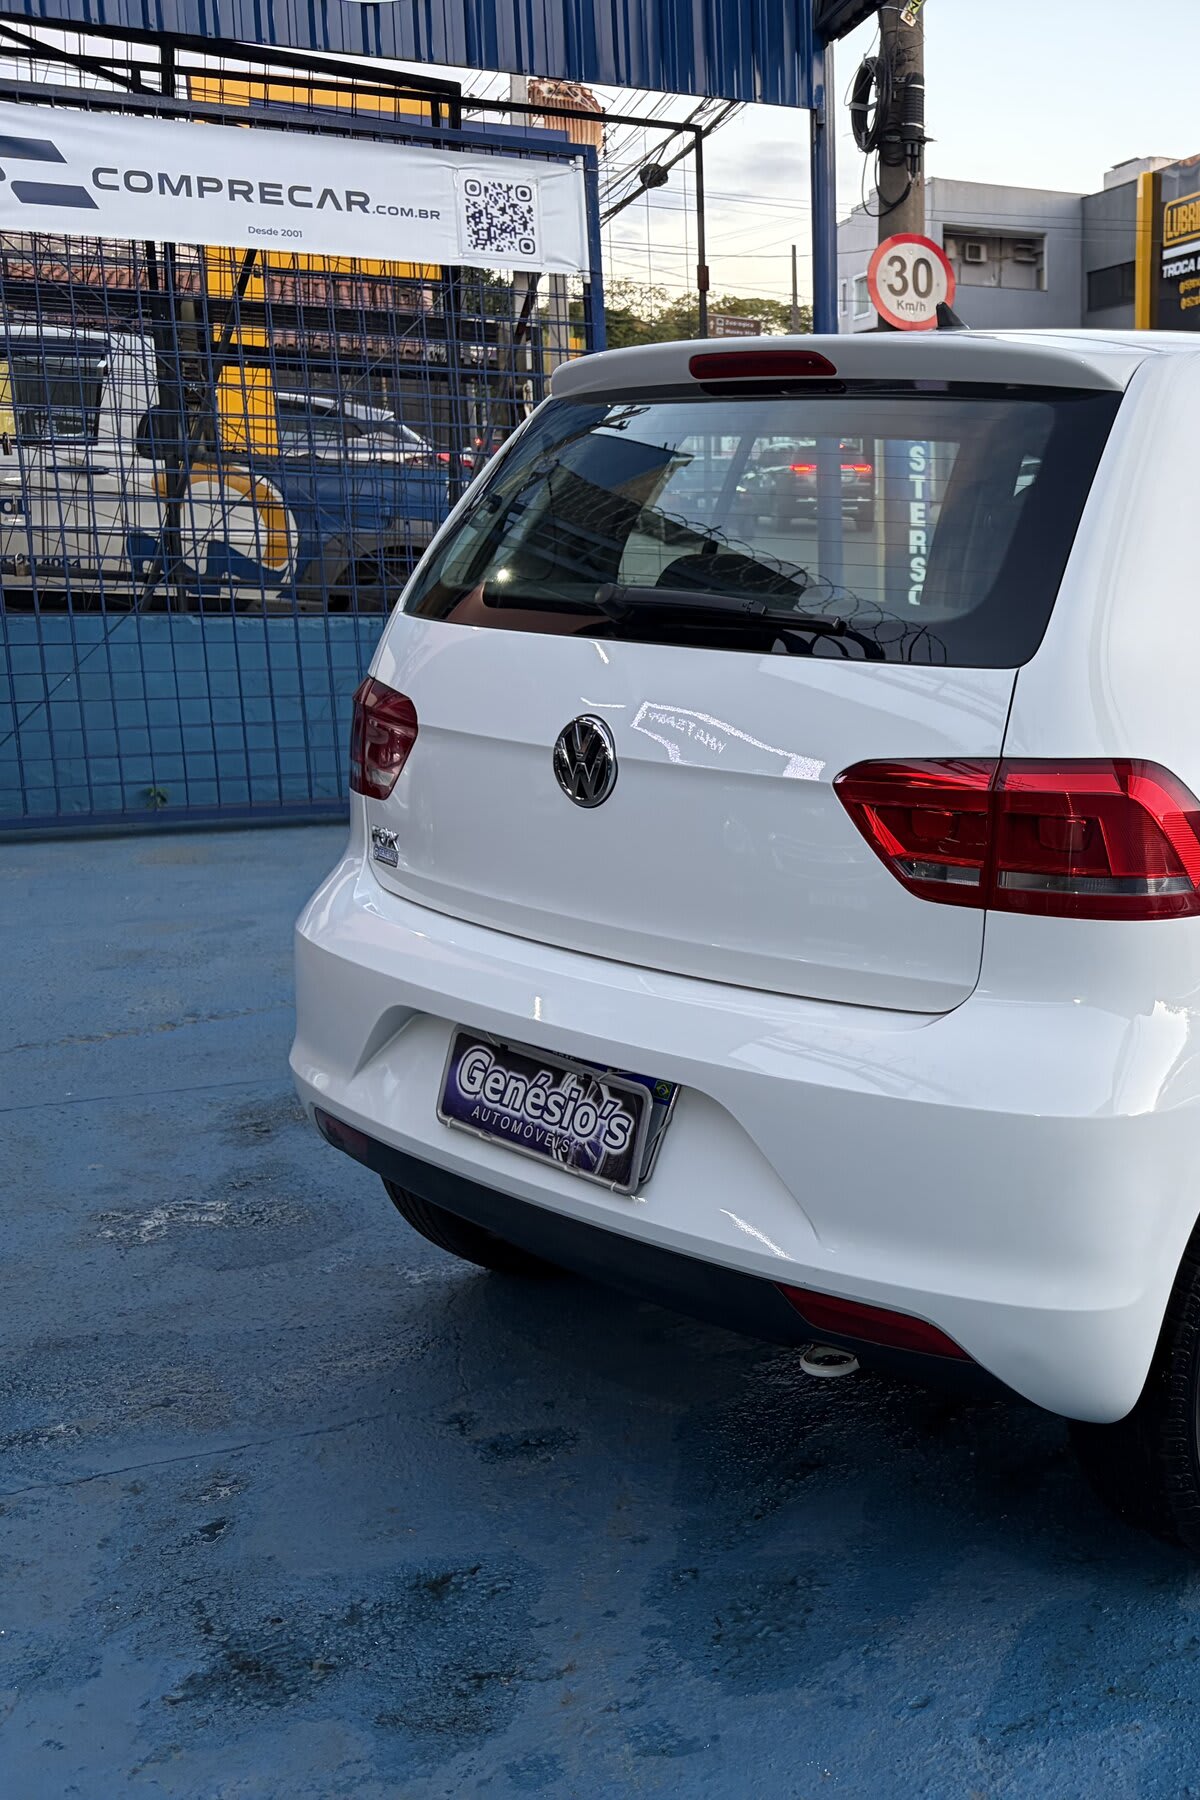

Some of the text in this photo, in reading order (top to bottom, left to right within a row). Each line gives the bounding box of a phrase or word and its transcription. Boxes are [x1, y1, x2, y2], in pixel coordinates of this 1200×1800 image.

[248, 226, 303, 238] Desde 2001
[887, 255, 933, 299] 30
[1162, 258, 1196, 278] TROCA
[896, 300, 927, 312] Km/h
[372, 824, 400, 851] FOX
[457, 1046, 635, 1152] Genésio's
[471, 1104, 571, 1154] AUTOMÓVEIS
